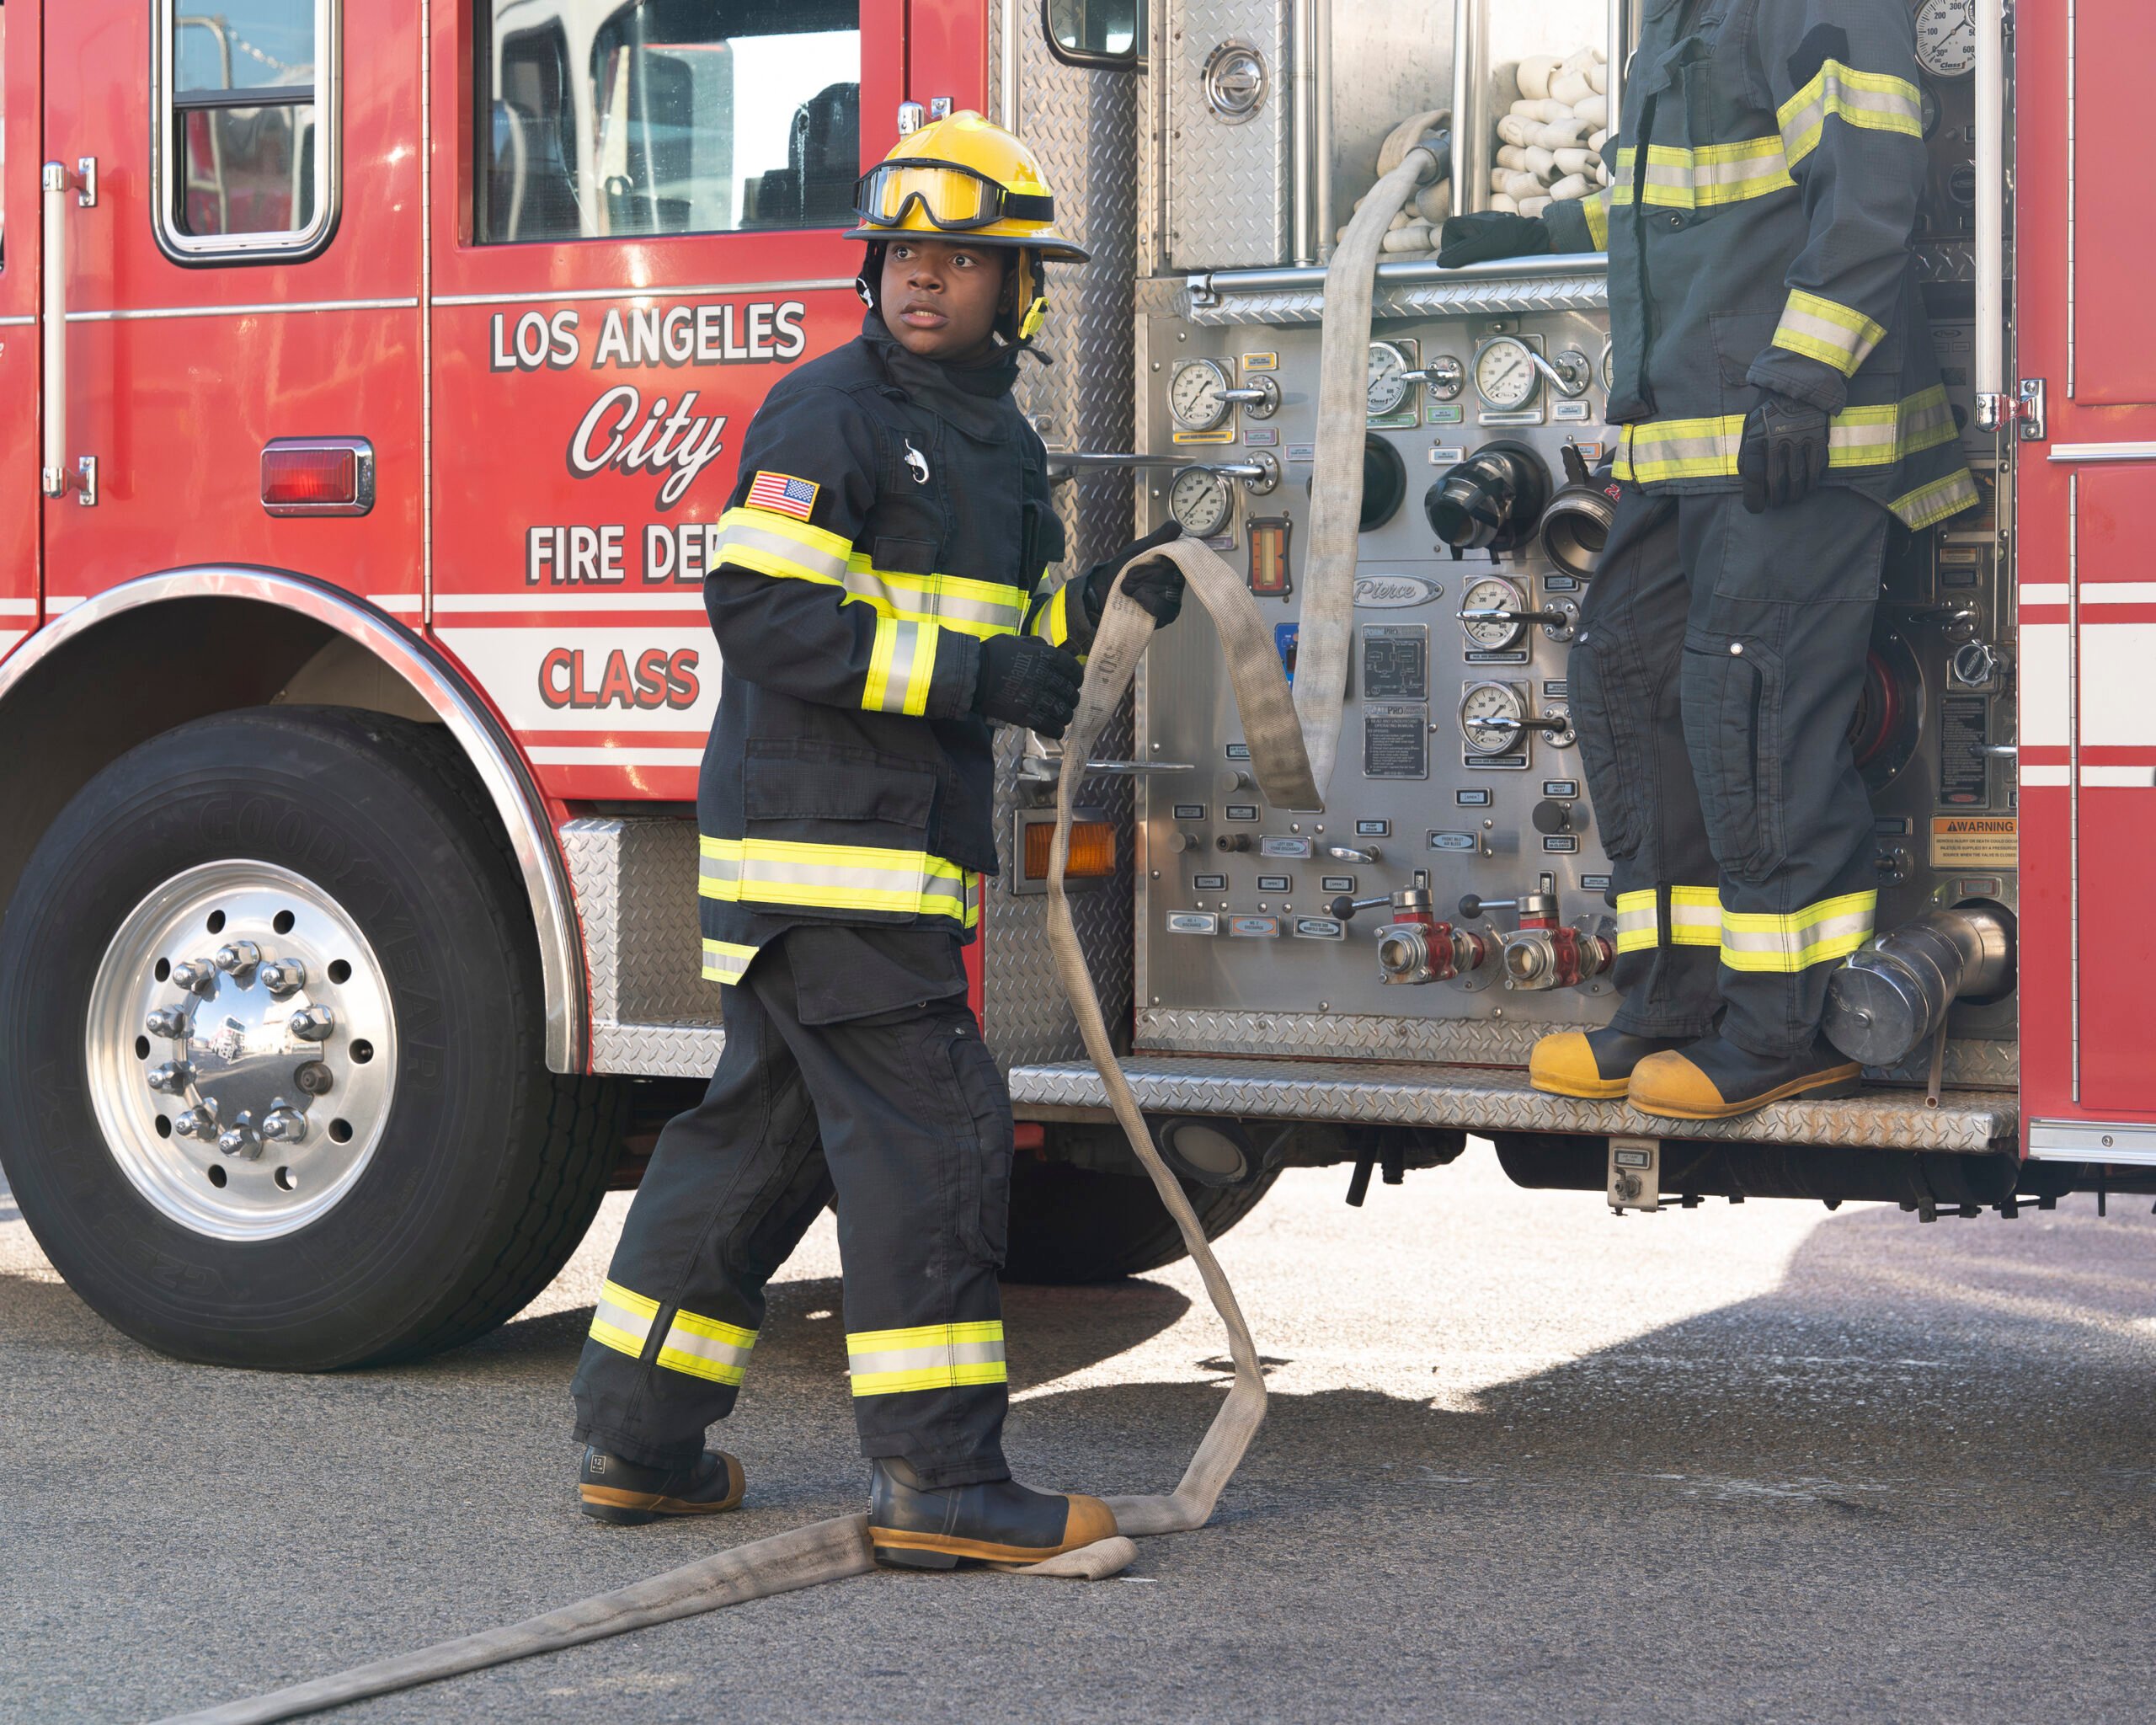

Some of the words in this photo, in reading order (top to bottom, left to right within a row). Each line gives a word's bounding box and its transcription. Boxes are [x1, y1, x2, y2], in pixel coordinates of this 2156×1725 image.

[490, 310, 579, 372] LOS
[591, 301, 806, 369] ANGELES
[566, 384, 728, 511] City
[526, 525, 625, 585] FIRE
[1354, 579, 1416, 603] Pierce
[538, 647, 700, 710] CLASS
[1957, 822, 2013, 831] WARNING
